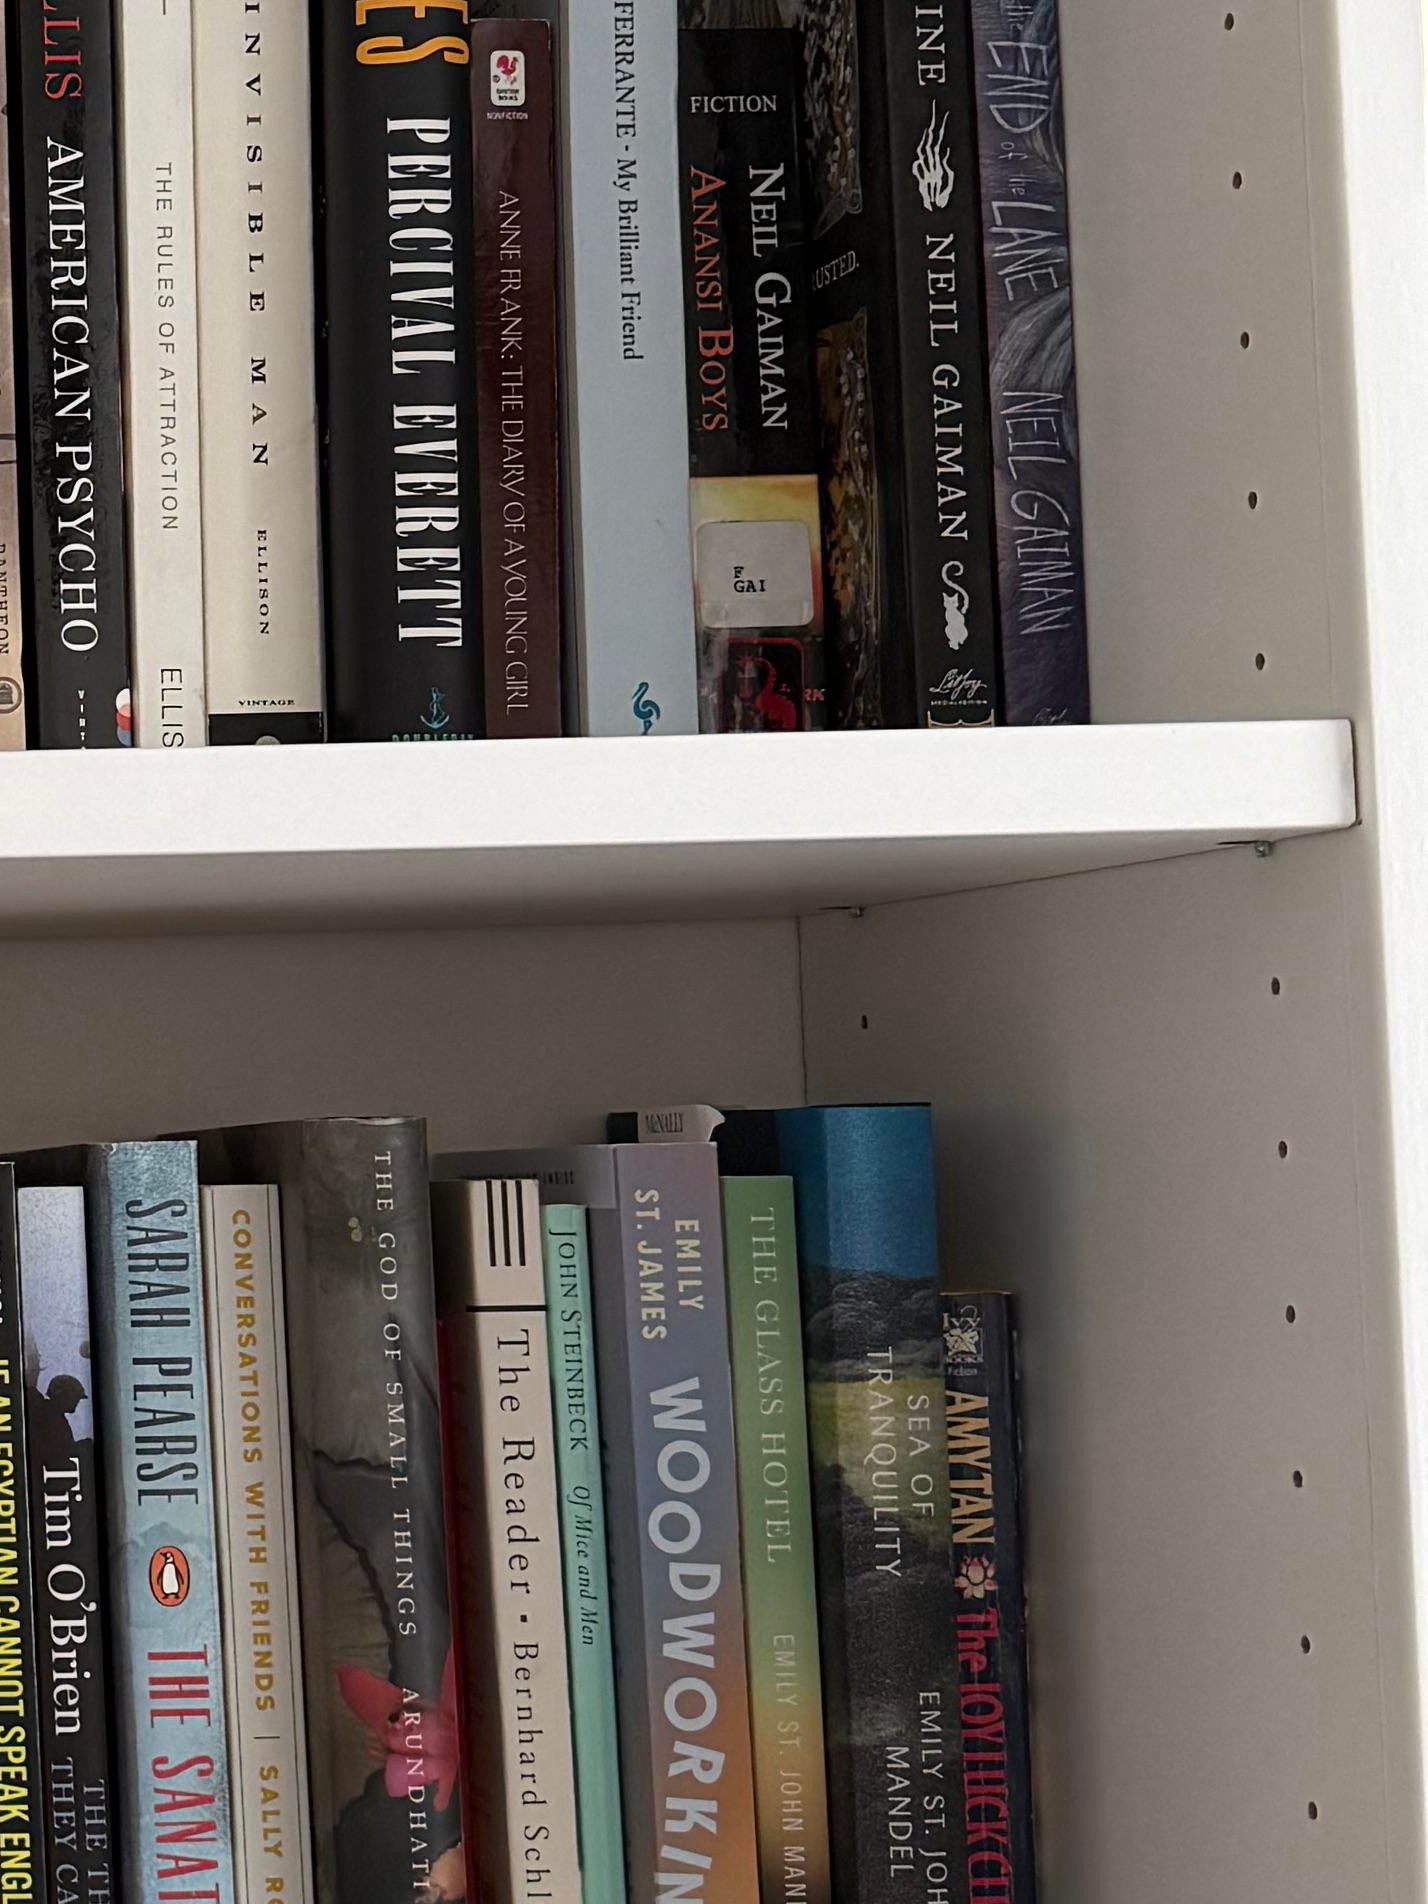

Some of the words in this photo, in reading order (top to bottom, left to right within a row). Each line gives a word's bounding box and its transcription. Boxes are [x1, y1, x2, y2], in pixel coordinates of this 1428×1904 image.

[245, 4, 264, 311] INVISIBLE
[691, 95, 776, 113] FICTION
[387, 118, 455, 374] PERCIVAL
[926, 234, 958, 346] NEIL
[251, 358, 268, 464] MAN
[933, 364, 967, 540] GAIMAN
[258, 530, 269, 634] ELLISON
[394, 405, 462, 646] EVERETT
[734, 578, 765, 592] GAI
[498, 1329, 530, 1411] The
[503, 1438, 539, 1594] Reader
[509, 1644, 546, 1808] Bernhard
